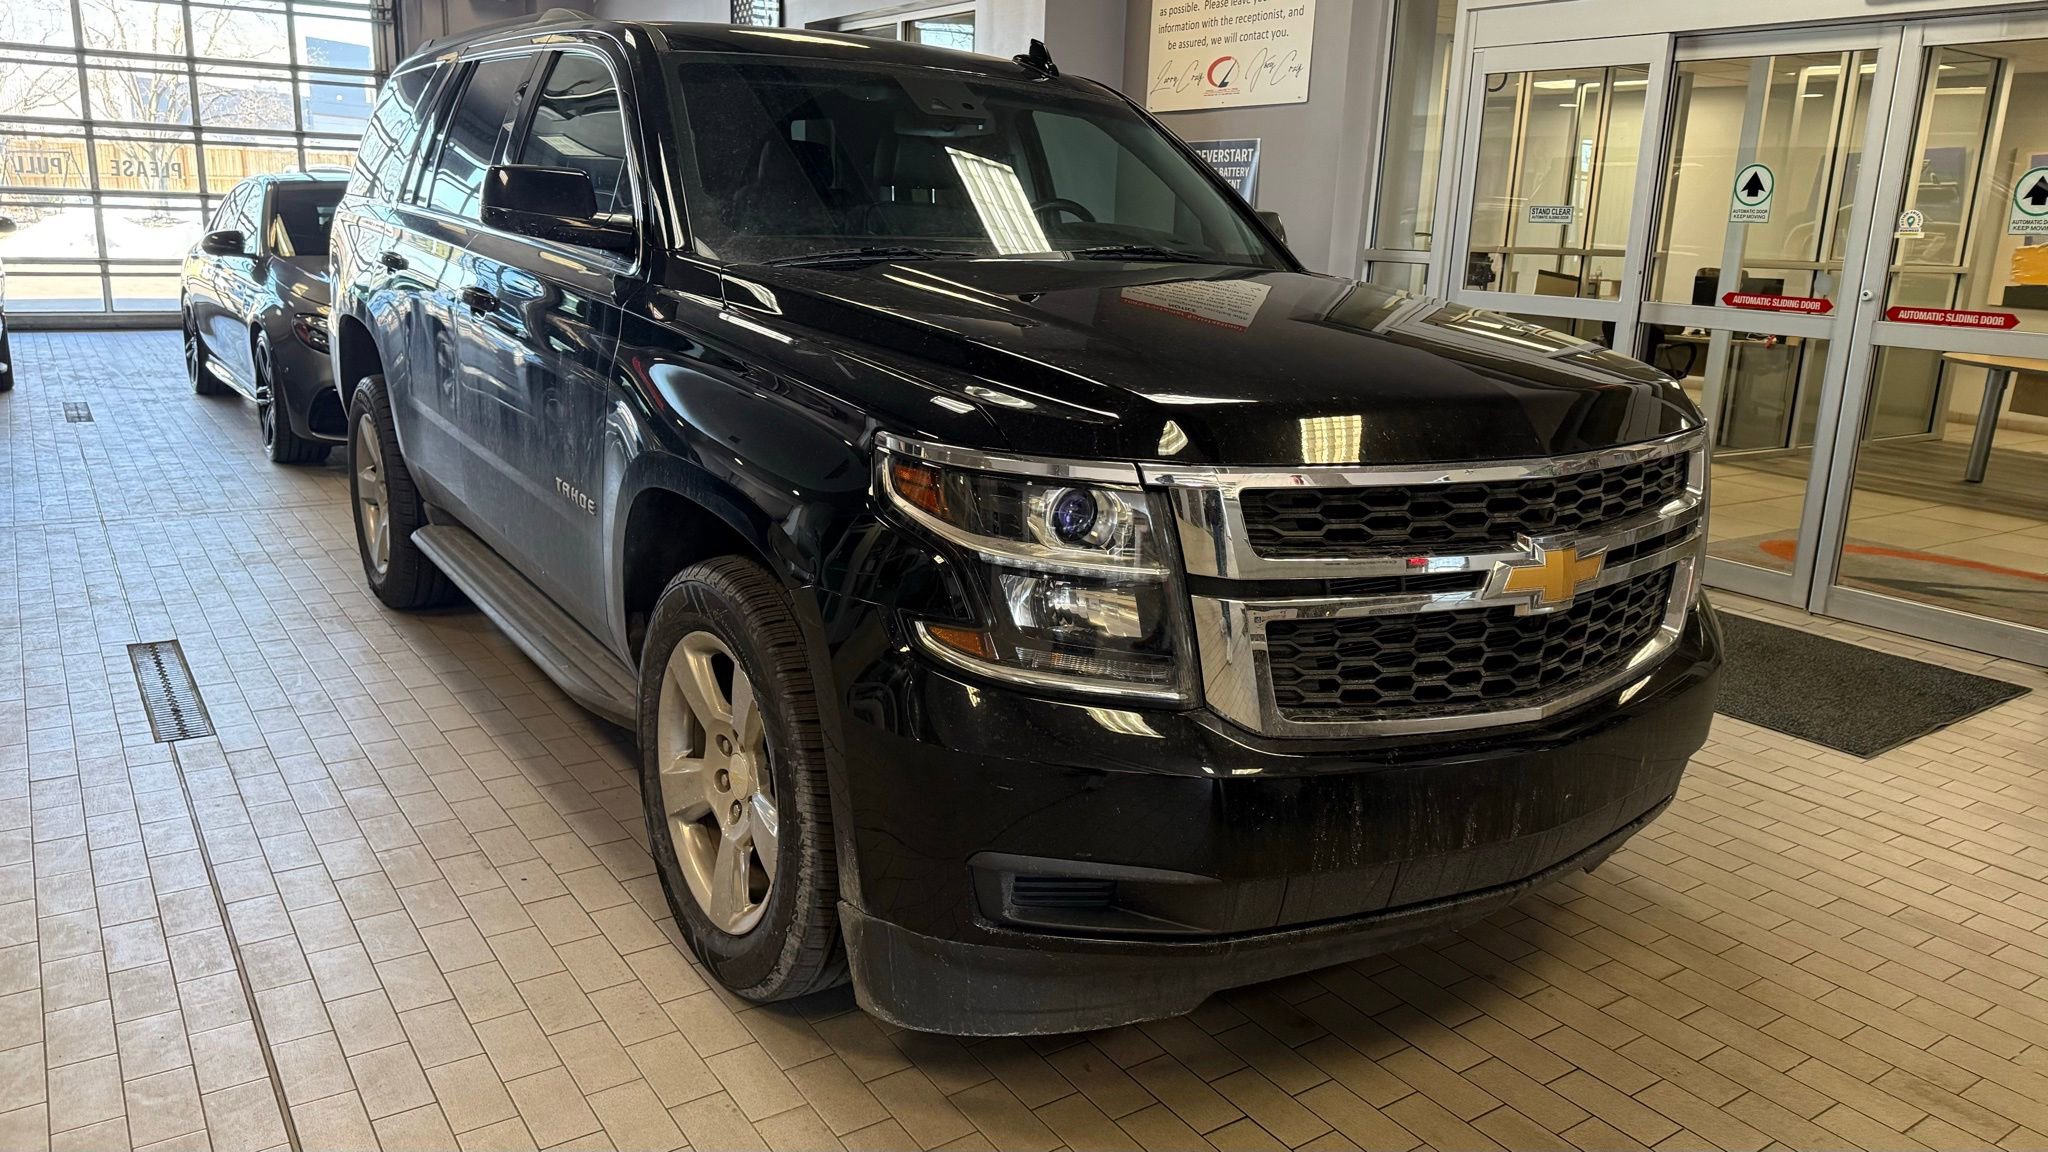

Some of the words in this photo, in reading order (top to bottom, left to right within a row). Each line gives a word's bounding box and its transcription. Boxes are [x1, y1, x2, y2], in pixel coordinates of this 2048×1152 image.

[1159, 8, 1167, 16] as
[1168, 2, 1200, 20] possible.
[1204, 0, 1228, 10] Please
[1158, 19, 1200, 34] information
[1201, 17, 1219, 29] with
[1220, 15, 1234, 26] the
[1235, 9, 1286, 24] receptionist,
[1288, 5, 1305, 18] and
[1167, 40, 1177, 50] be
[1178, 36, 1209, 49] assured,
[1210, 36, 1222, 46] we
[1224, 32, 1238, 43] will
[1239, 29, 1269, 42] contact
[1271, 28, 1289, 41] you.
[1196, 148, 1254, 162] EVERSTART
[1219, 166, 1250, 177] BATTERY
[1732, 294, 1771, 306] AUTOMATIC
[1771, 298, 1800, 309] SLIDING
[1800, 300, 1822, 310] DOOR
[1898, 310, 1945, 322] AUTOMATIC
[1945, 313, 1979, 325] SLIDING
[1979, 315, 2005, 326] DOOR
[555, 476, 595, 516] TAHOE
